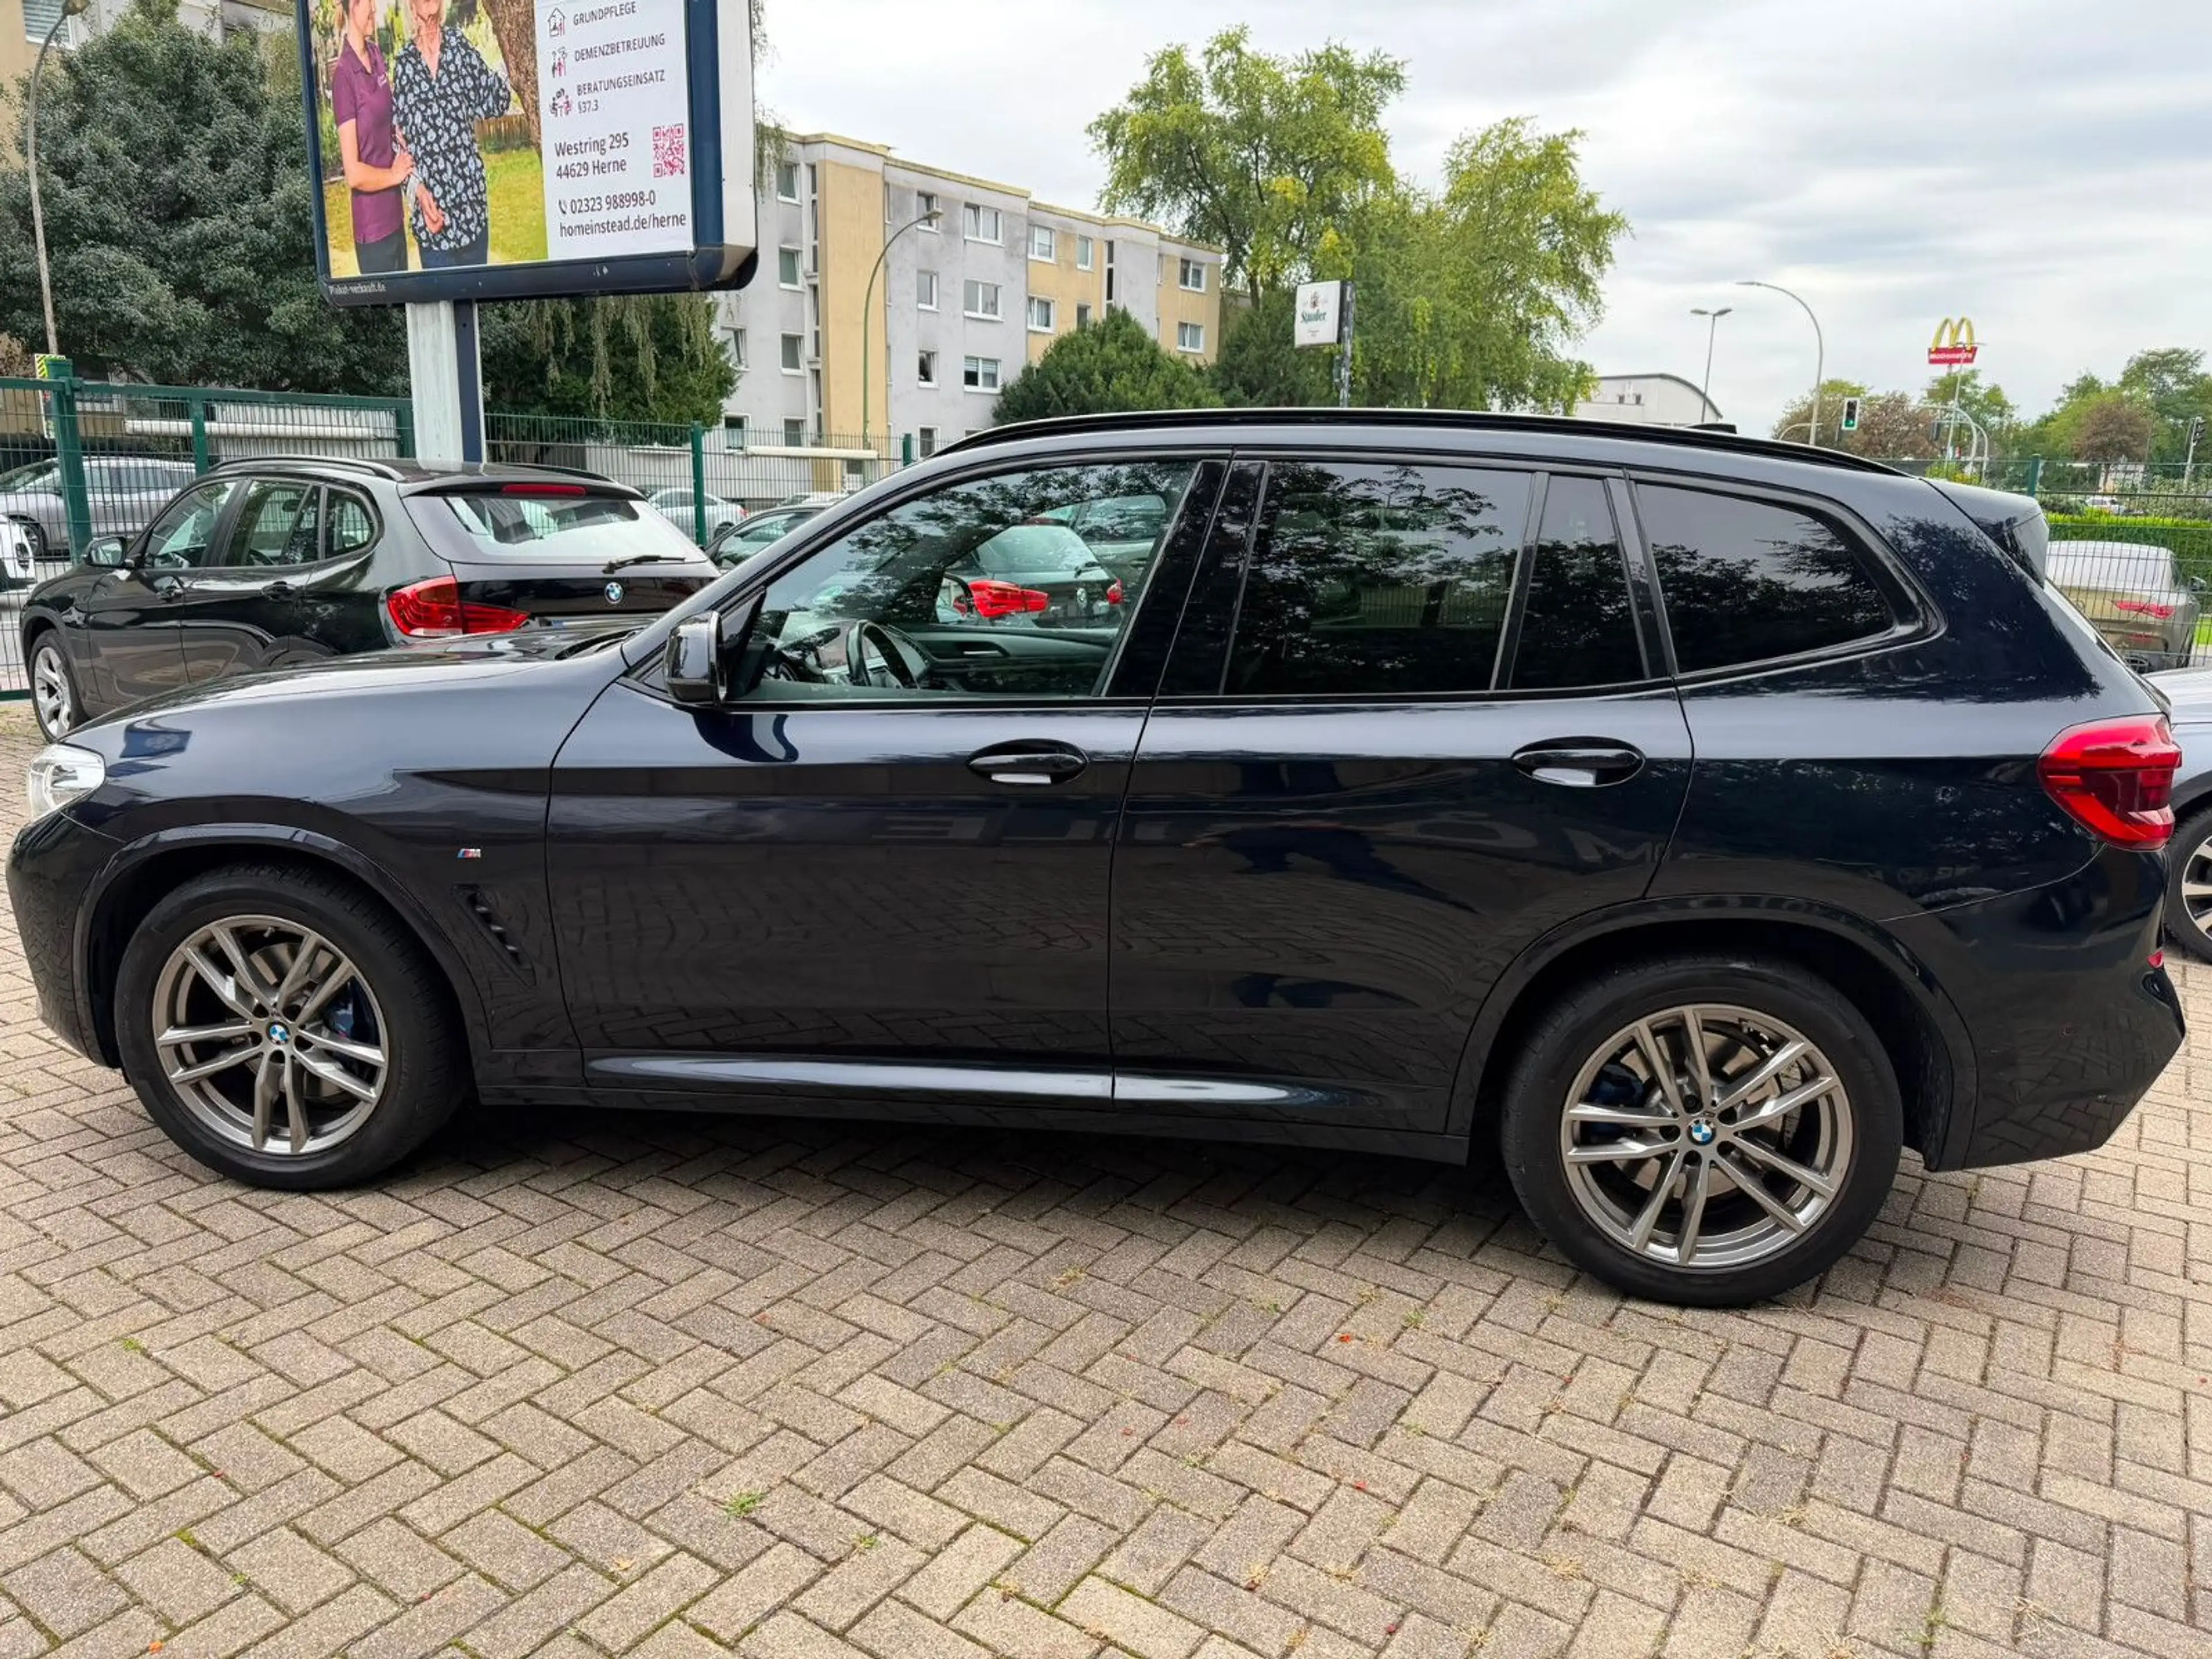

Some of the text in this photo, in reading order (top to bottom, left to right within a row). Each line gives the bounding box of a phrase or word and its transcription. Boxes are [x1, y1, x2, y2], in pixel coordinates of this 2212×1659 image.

[573, 2, 637, 25] GRUNDPFLEGE
[574, 33, 665, 62] DEMENZBETREUUNG
[577, 70, 665, 96] BERATUNGSEINSATZ
[578, 100, 599, 113] §37.3
[555, 132, 629, 157] Westring 295
[556, 159, 626, 179] 44629 Herne
[570, 190, 656, 214] 02323 988998-0
[560, 213, 686, 237] homeinstead.de/herne
